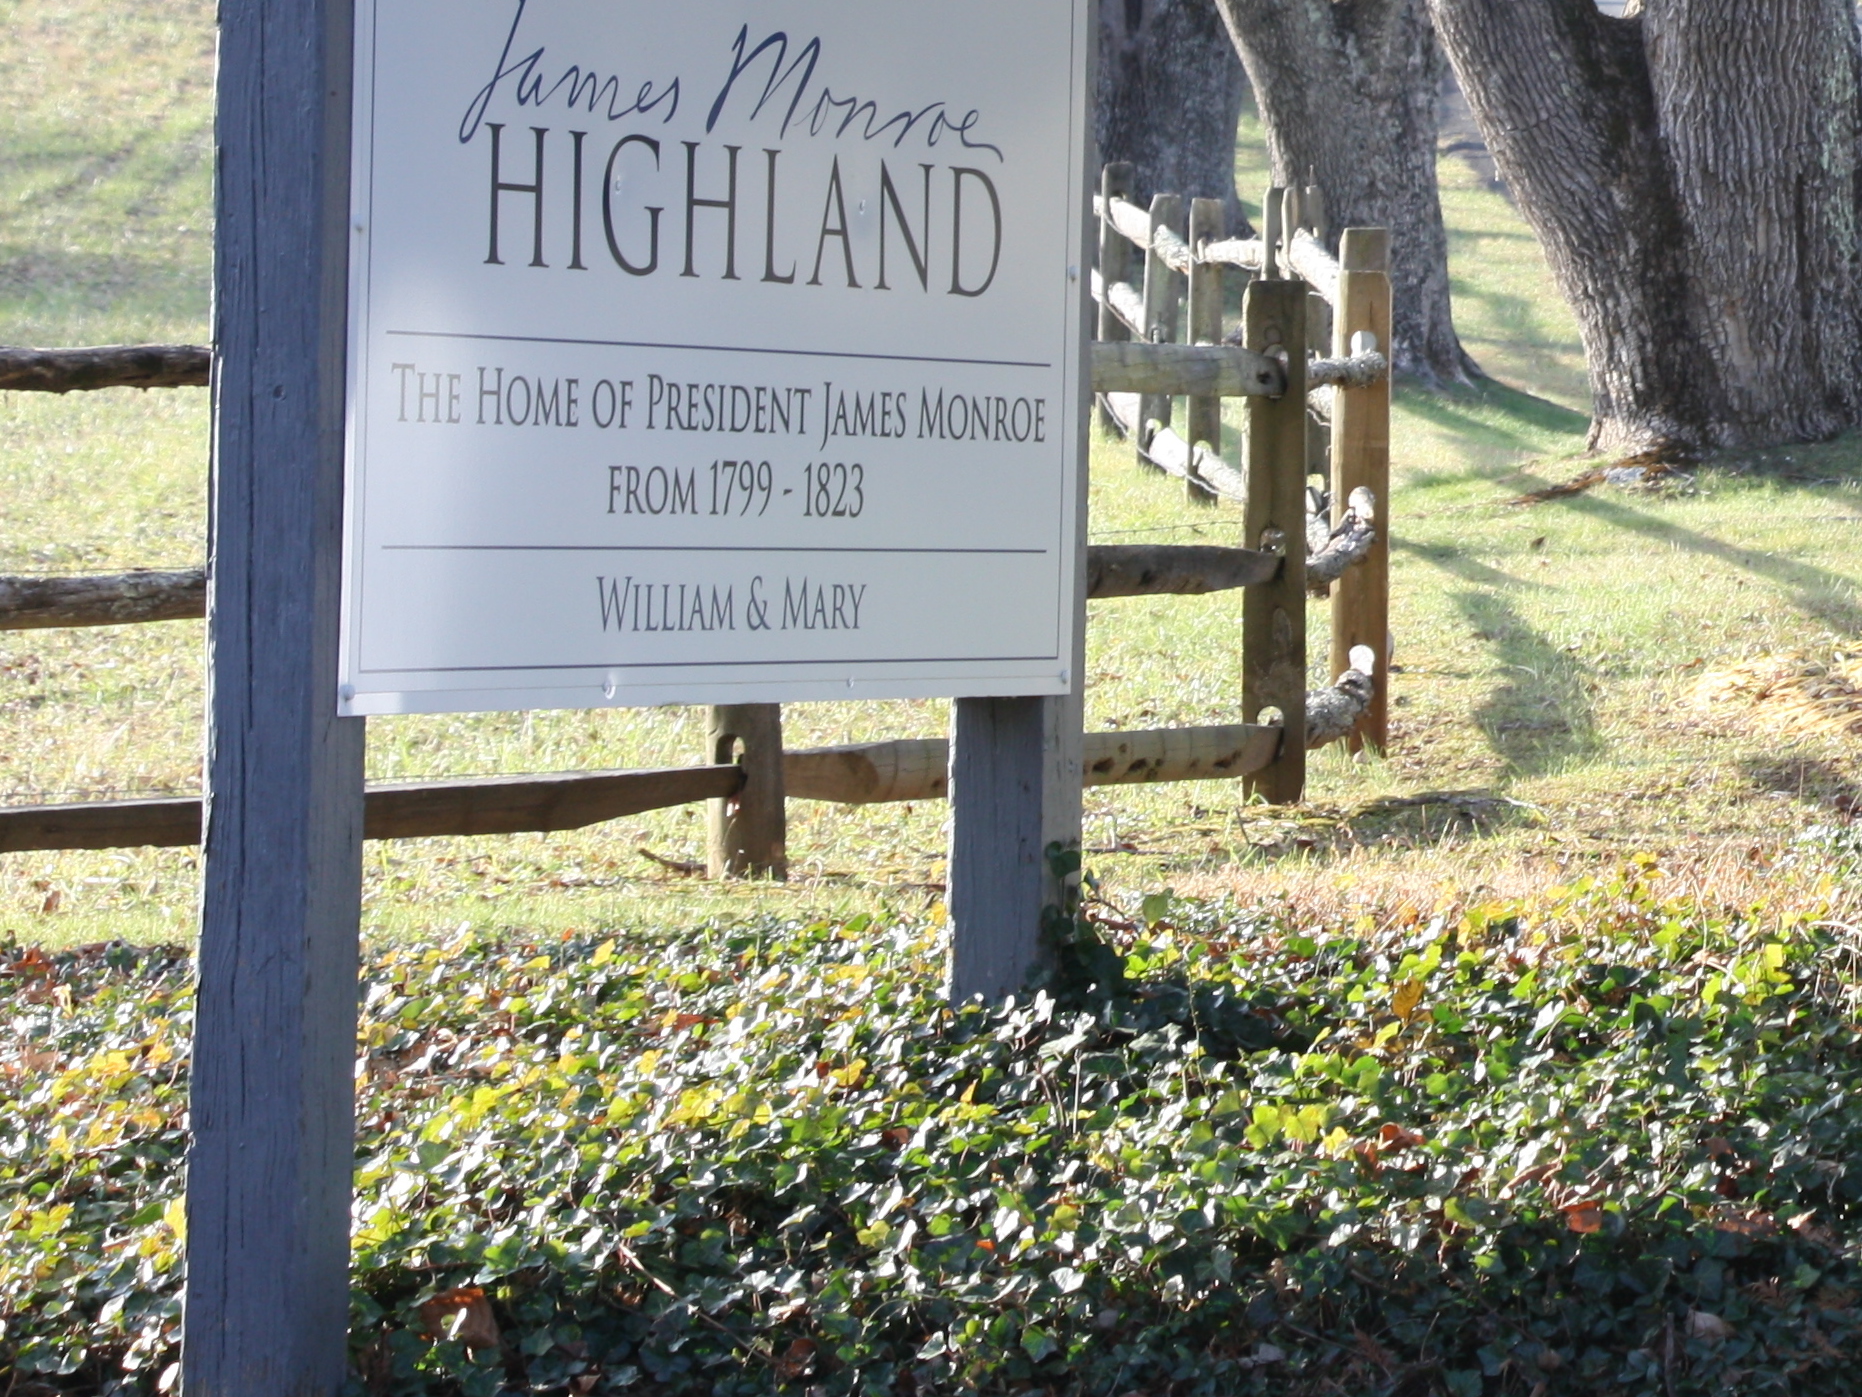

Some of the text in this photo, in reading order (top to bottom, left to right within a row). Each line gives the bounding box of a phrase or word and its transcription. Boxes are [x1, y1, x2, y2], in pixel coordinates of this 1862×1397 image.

[706, 22, 1005, 163] Monroe
[483, 121, 1003, 298] HIGHLAND
[391, 362, 1047, 451] THE HOME OF PRESIDENT JAMES MONROE
[606, 465, 699, 516] FROM
[709, 459, 774, 518] 1799
[803, 462, 865, 519] 1823
[596, 574, 867, 634] WILLIAM & MARY
